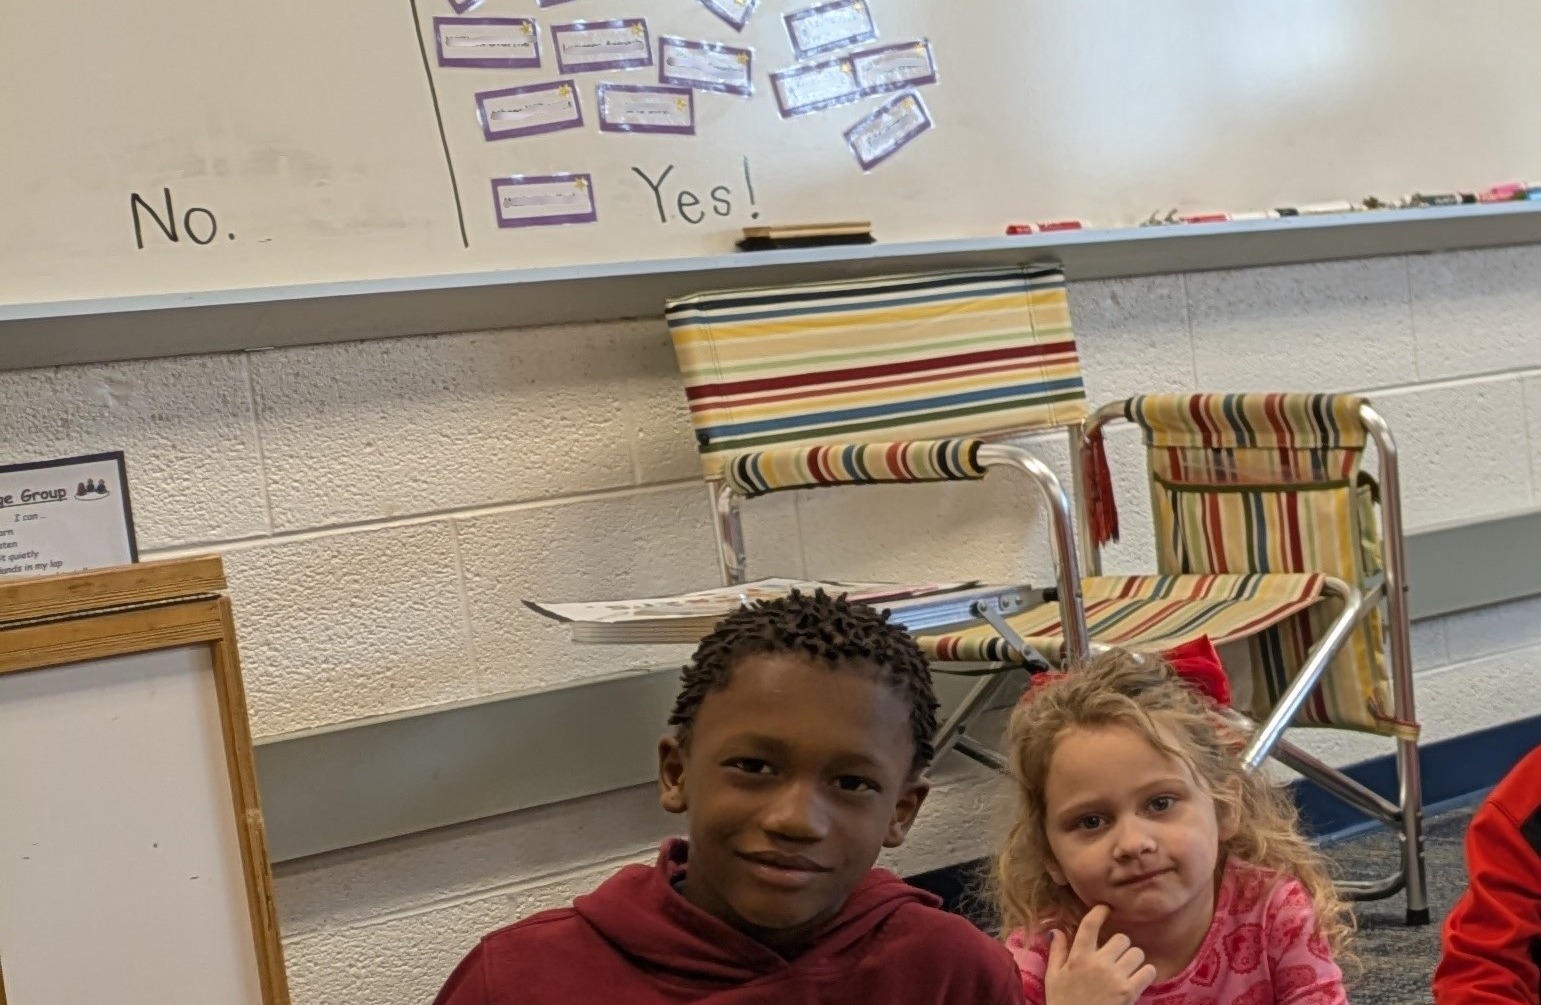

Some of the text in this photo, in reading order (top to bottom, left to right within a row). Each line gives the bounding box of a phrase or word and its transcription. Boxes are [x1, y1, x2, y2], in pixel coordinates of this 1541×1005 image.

[631, 155, 760, 224] Yes!
[131, 187, 235, 250] No.
[21, 488, 67, 502] Group
[23, 513, 38, 521] can
[8, 550, 39, 562] quietly
[25, 563, 33, 571] in
[35, 562, 47, 571] my
[50, 560, 63, 569] lap
